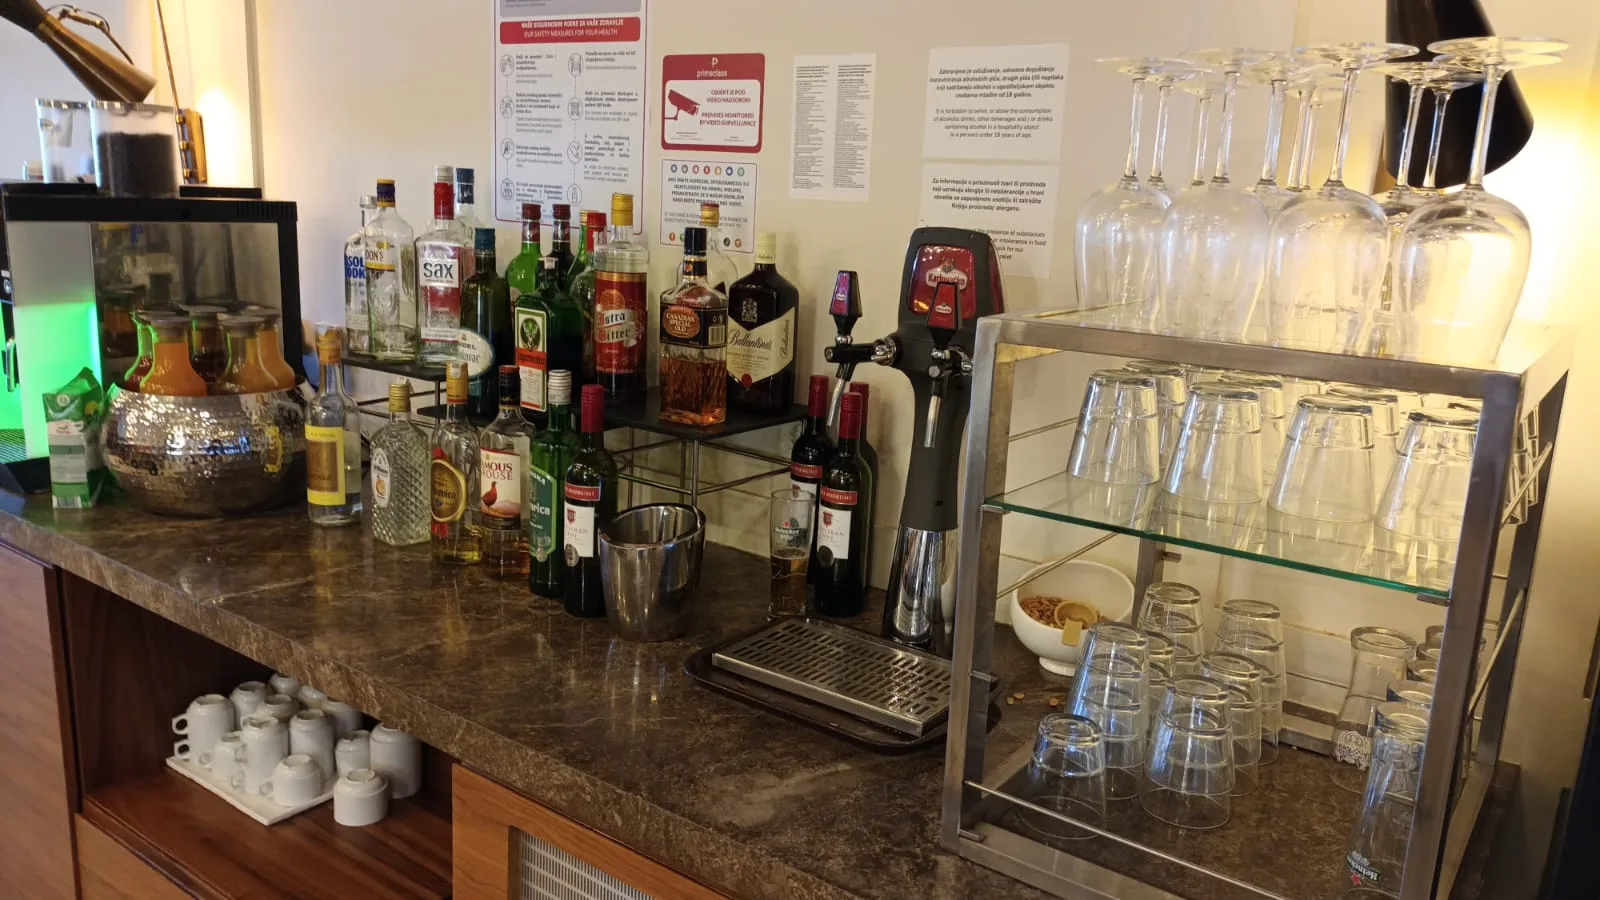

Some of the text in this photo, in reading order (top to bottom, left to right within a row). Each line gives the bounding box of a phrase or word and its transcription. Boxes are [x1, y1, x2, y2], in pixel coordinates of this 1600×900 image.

[534, 30, 550, 38] SAFETY
[598, 28, 618, 36] HEALTH
[696, 69, 728, 78] primeclass
[423, 262, 454, 280] sax
[480, 461, 513, 472] AMOUS
